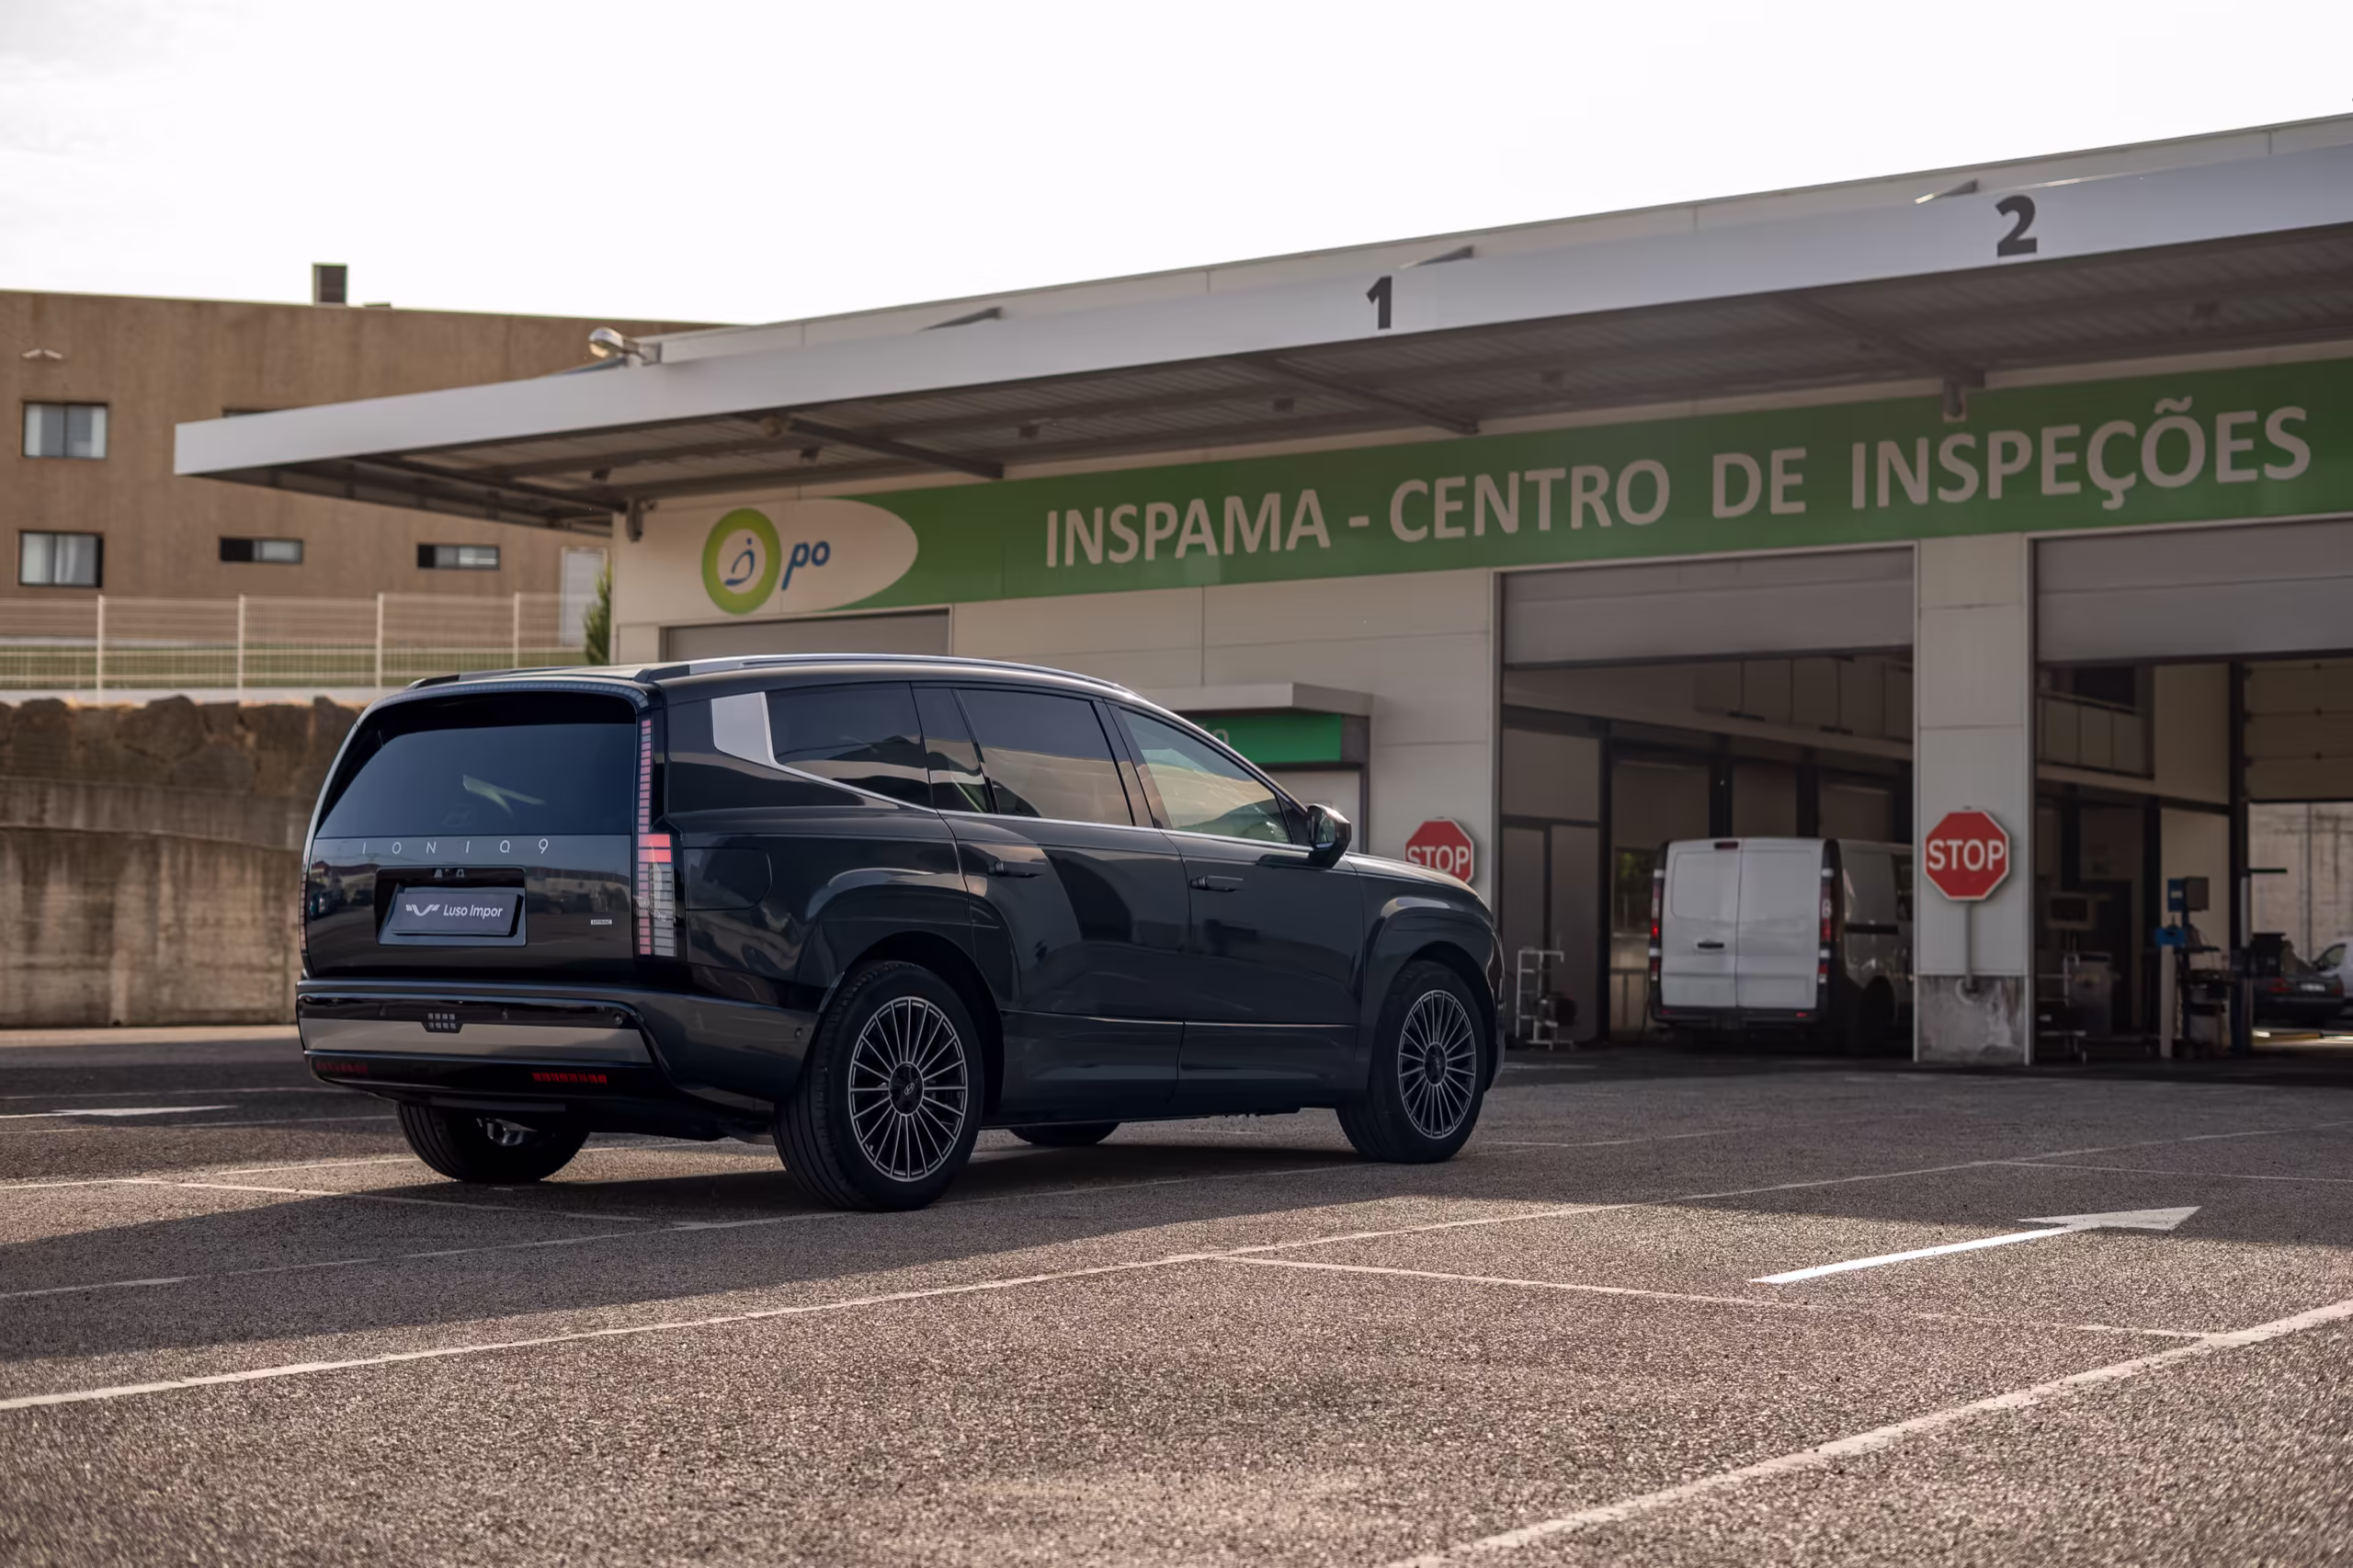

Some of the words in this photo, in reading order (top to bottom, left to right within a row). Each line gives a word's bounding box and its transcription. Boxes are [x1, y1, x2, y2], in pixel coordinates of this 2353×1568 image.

[1995, 194, 2037, 257] 2
[1366, 275, 1392, 330] 1
[1047, 489, 1331, 567] INSPAMA
[1390, 460, 1670, 542] CENTRO
[1712, 448, 1807, 518] DE
[1852, 396, 2311, 510] INSPEÇÕES
[1407, 845, 1470, 874] STOP
[1928, 839, 2005, 870] STOP
[443, 904, 468, 916] Luso
[470, 904, 503, 919] Impor
